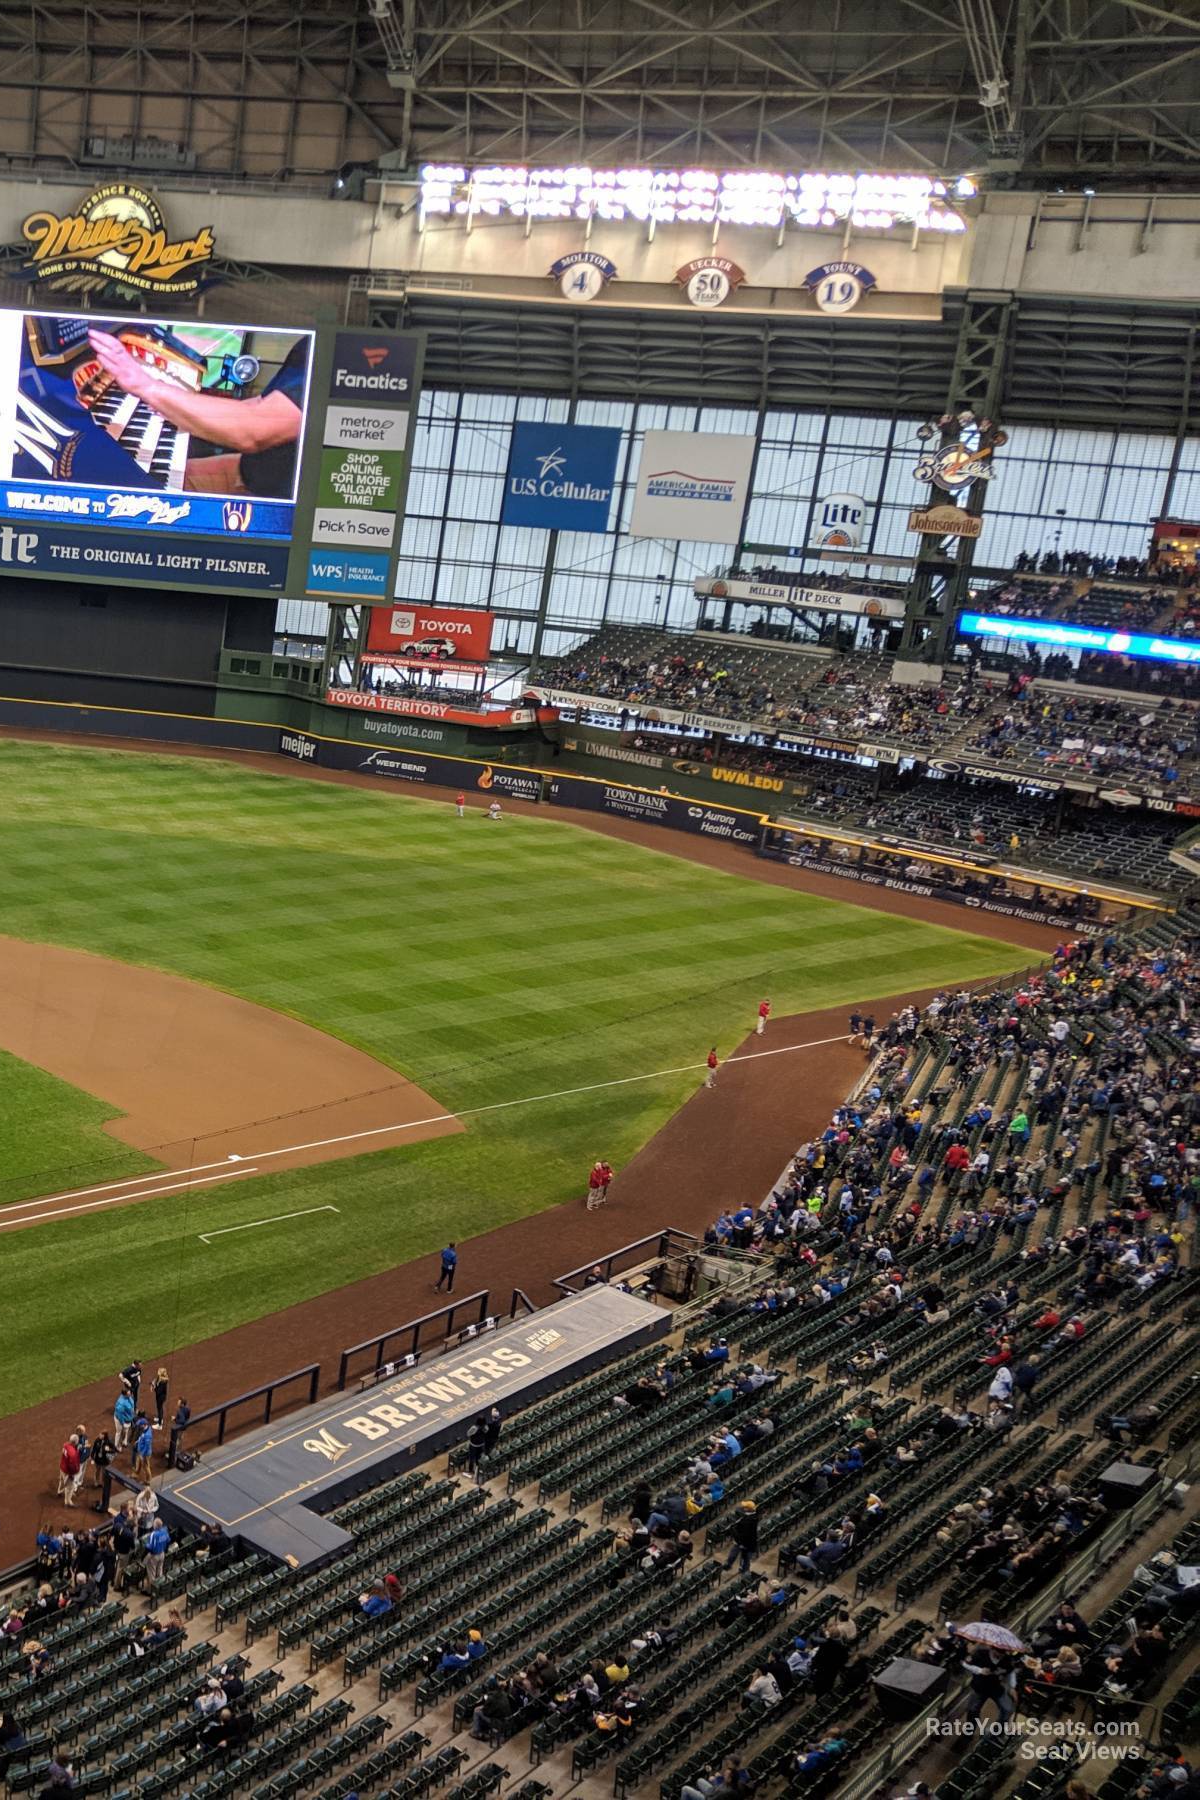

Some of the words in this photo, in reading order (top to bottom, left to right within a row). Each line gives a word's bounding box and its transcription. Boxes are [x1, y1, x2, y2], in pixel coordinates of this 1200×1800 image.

[91, 185, 126, 204] SINCE
[128, 187, 152, 206] 2001
[23, 212, 141, 261] Miller
[116, 226, 216, 281] Park
[561, 252, 608, 270] MOLITOR
[689, 259, 732, 272] UECKER
[824, 264, 862, 277] YOUNT
[38, 262, 64, 278] HOME
[65, 262, 79, 271] OF
[81, 261, 98, 272] THE
[99, 266, 151, 290] MILWAUKEE
[152, 279, 198, 293] BREWERS
[572, 271, 587, 293] 4
[696, 272, 721, 293] 50
[823, 281, 854, 305] 19
[335, 369, 408, 391] Fanatics
[340, 416, 380, 428] metro
[339, 428, 385, 440] market
[341, 463, 383, 475] ONLINE
[347, 453, 379, 464] SHOP
[330, 473, 353, 483] FOR
[357, 475, 391, 486] MORE
[333, 483, 385, 496] TAILGATE
[511, 477, 538, 496] U.S.
[540, 480, 610, 501] Cellular
[648, 479, 697, 491] AMERICAN
[700, 483, 734, 494] FAMILY
[6, 491, 90, 514] WELCOME
[92, 502, 106, 513] TO
[343, 494, 373, 505] TIME!
[652, 488, 726, 500] INSURANCE
[822, 503, 862, 528] Lite
[911, 516, 980, 535] Johnsonville
[319, 520, 345, 533] Pick
[358, 523, 390, 536] Save
[50, 545, 80, 560] THE
[84, 548, 152, 566] ORIGINAL
[156, 554, 202, 570] LIGHT
[205, 559, 270, 575] PILSNER.
[312, 564, 342, 578] WPS
[348, 567, 374, 575] HEALTH
[348, 573, 385, 582] INSURANCE
[749, 586, 785, 598] MILLER
[814, 594, 842, 605] DECK
[419, 620, 473, 635] TOYOTA
[330, 691, 378, 708] TOYOTA
[379, 698, 450, 717] TERRITORY
[364, 718, 443, 741] buyatoyota.com
[282, 735, 316, 759] meijer
[375, 758, 400, 769] WEST
[401, 763, 427, 773] BEND
[712, 767, 784, 791] UWM.EDU
[605, 787, 638, 803] TOWN
[638, 795, 669, 812] BANK
[704, 811, 736, 825] Aurora
[701, 821, 732, 837] Health
[733, 828, 755, 842] Care
[803, 860, 831, 873] Aurora
[831, 866, 860, 880] Health
[860, 872, 881, 884] Care
[885, 879, 932, 896] BULLPEN
[981, 900, 1013, 916] Aurora
[1014, 908, 1047, 923] Health
[1047, 916, 1072, 928] Care
[383, 1375, 414, 1395] HOME
[415, 1370, 428, 1382] OF
[429, 1361, 450, 1377] THE
[342, 1347, 533, 1441] BREWERS
[440, 1399, 472, 1420] SINCE
